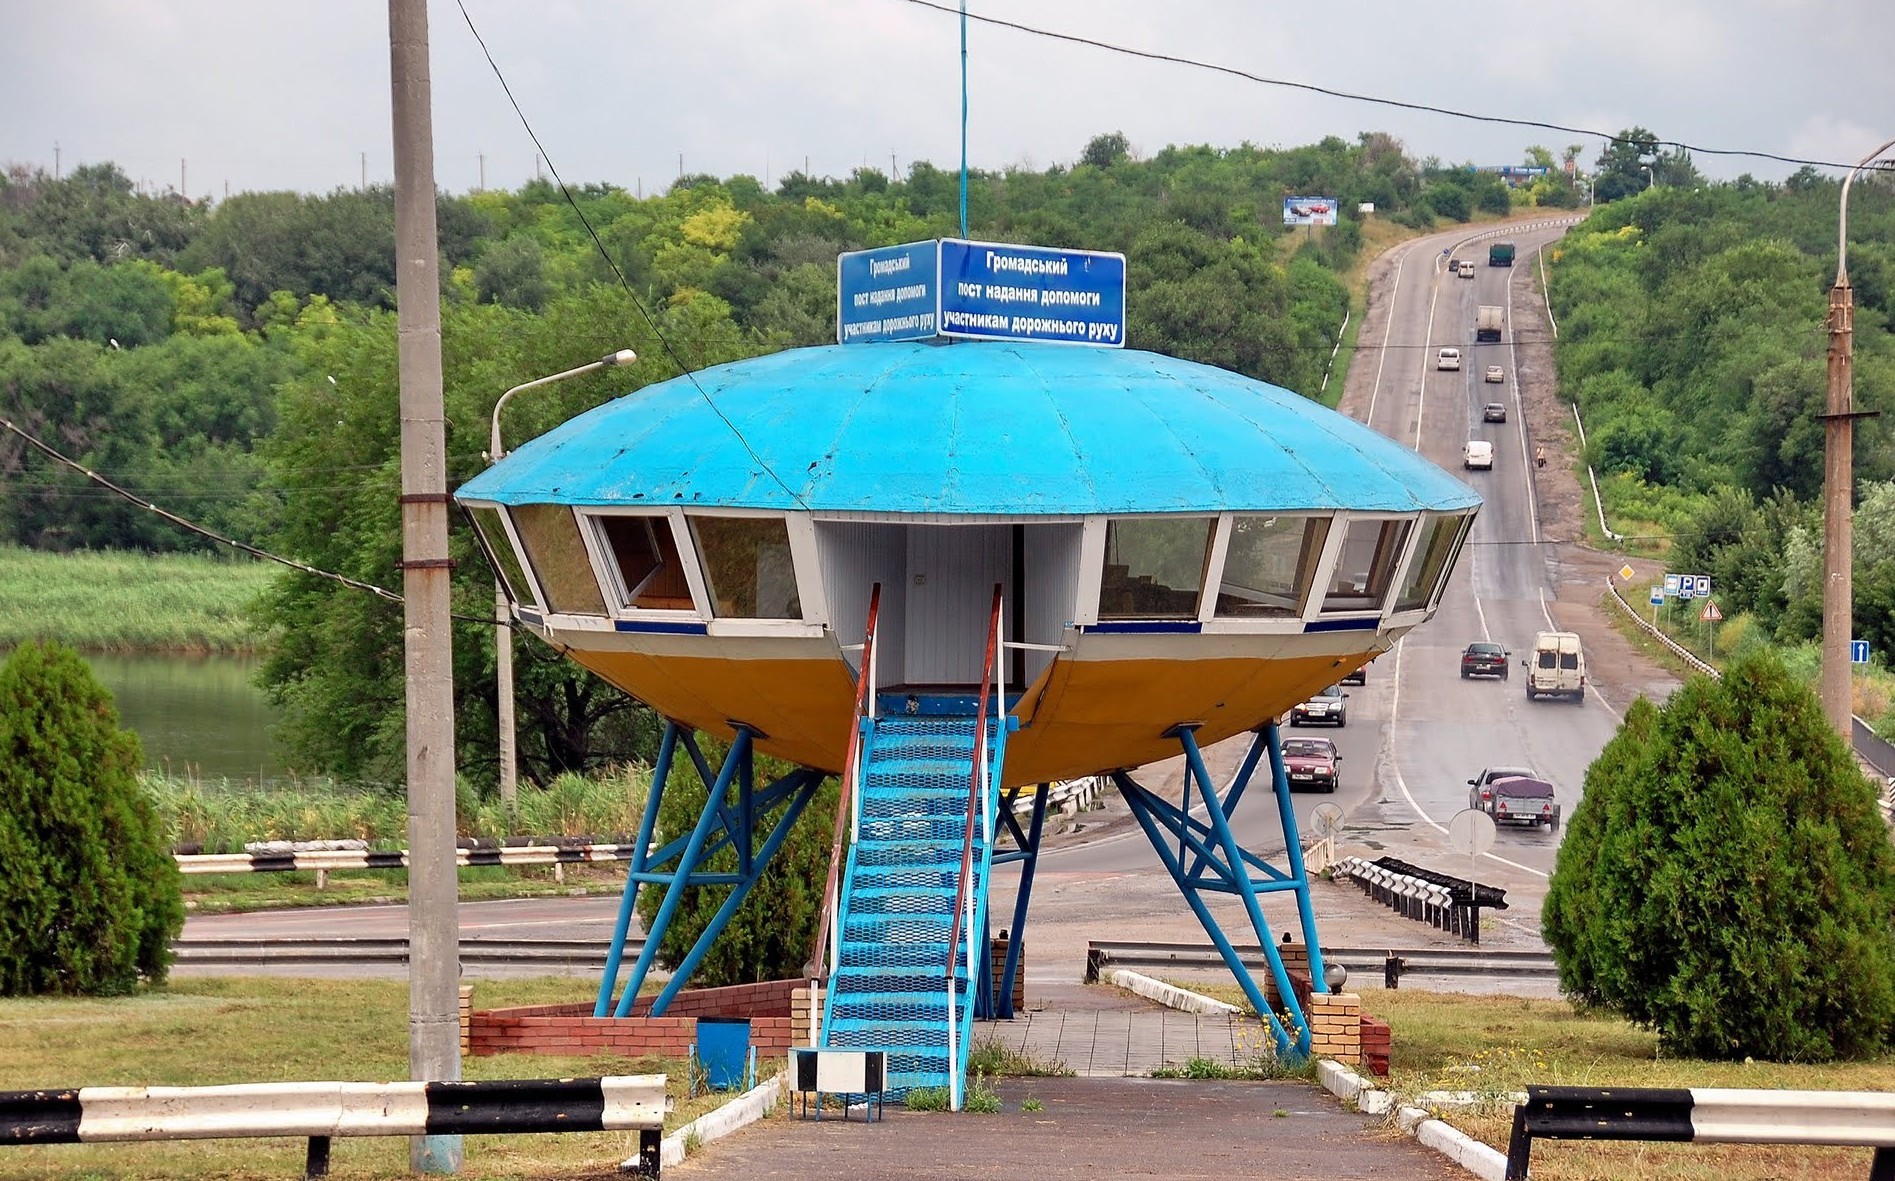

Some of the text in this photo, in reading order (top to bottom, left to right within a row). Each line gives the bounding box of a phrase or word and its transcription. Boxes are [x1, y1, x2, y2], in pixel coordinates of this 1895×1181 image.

[870, 253, 910, 279] Громадський
[986, 250, 1068, 275] Громадський
[854, 284, 926, 306] пост надання допомоги
[958, 281, 1100, 307] пост надання допомоги
[844, 313, 935, 340] участникам дорожнього руху
[943, 310, 1118, 341] участникам дорожнього руху
[1683, 577, 1693, 590] P
